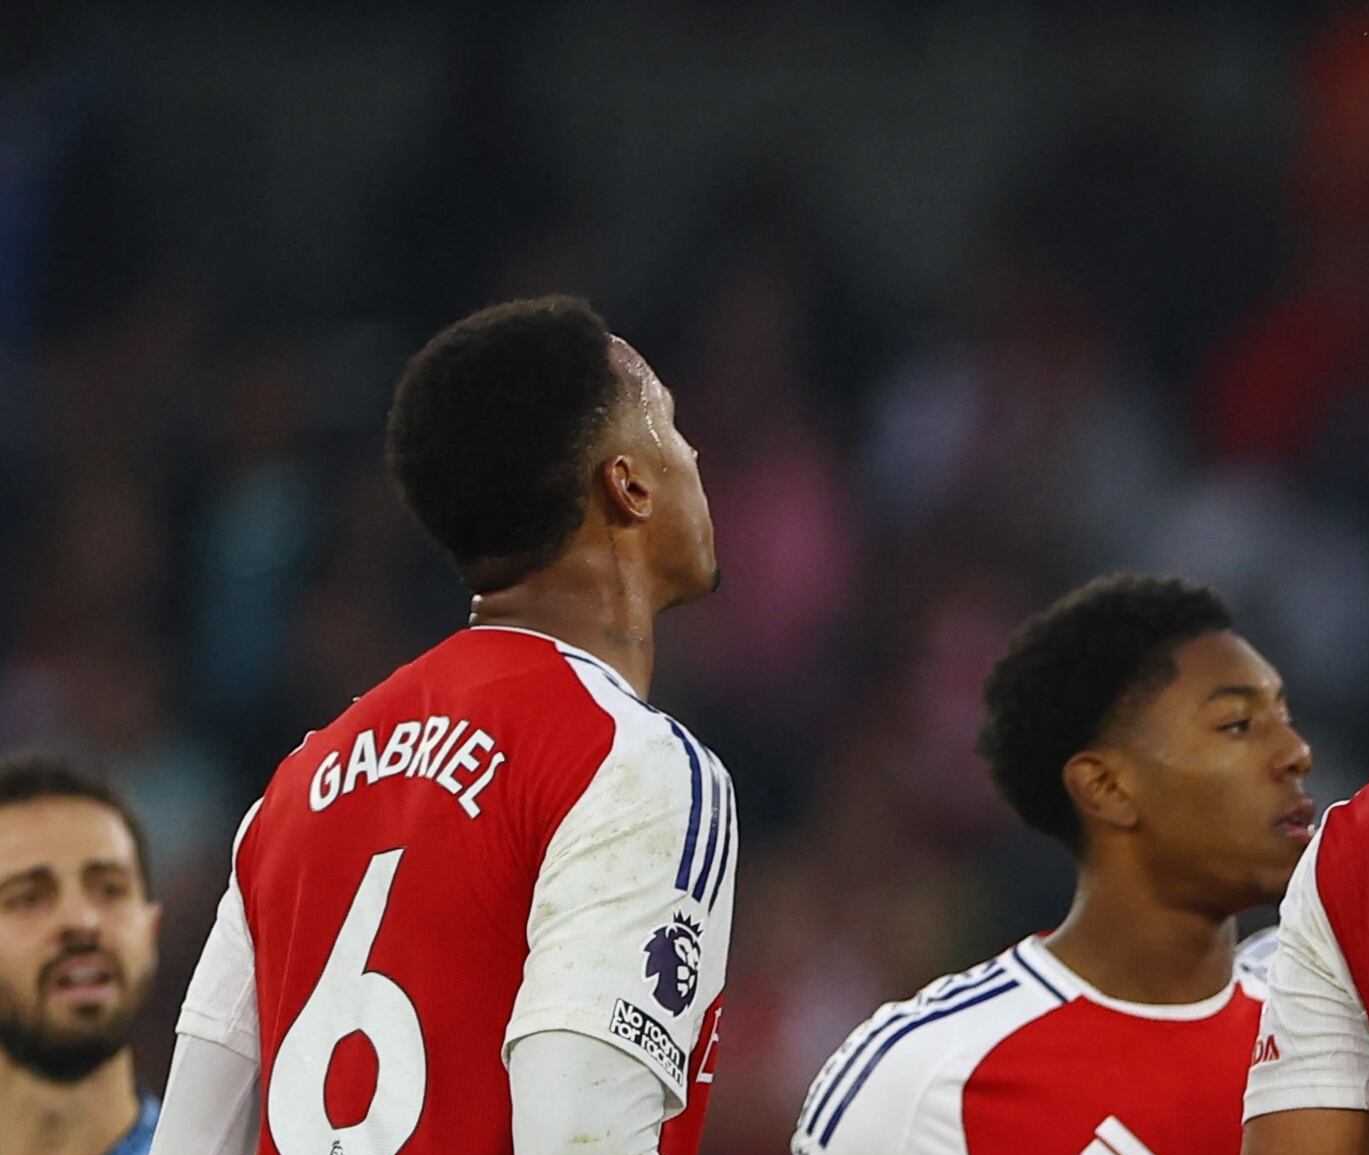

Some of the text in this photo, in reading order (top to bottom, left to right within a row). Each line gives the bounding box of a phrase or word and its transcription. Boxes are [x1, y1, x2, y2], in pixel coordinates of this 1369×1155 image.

[309, 715, 506, 820] GABRIEL
[613, 999, 643, 1029] No
[644, 1019, 681, 1067] room
